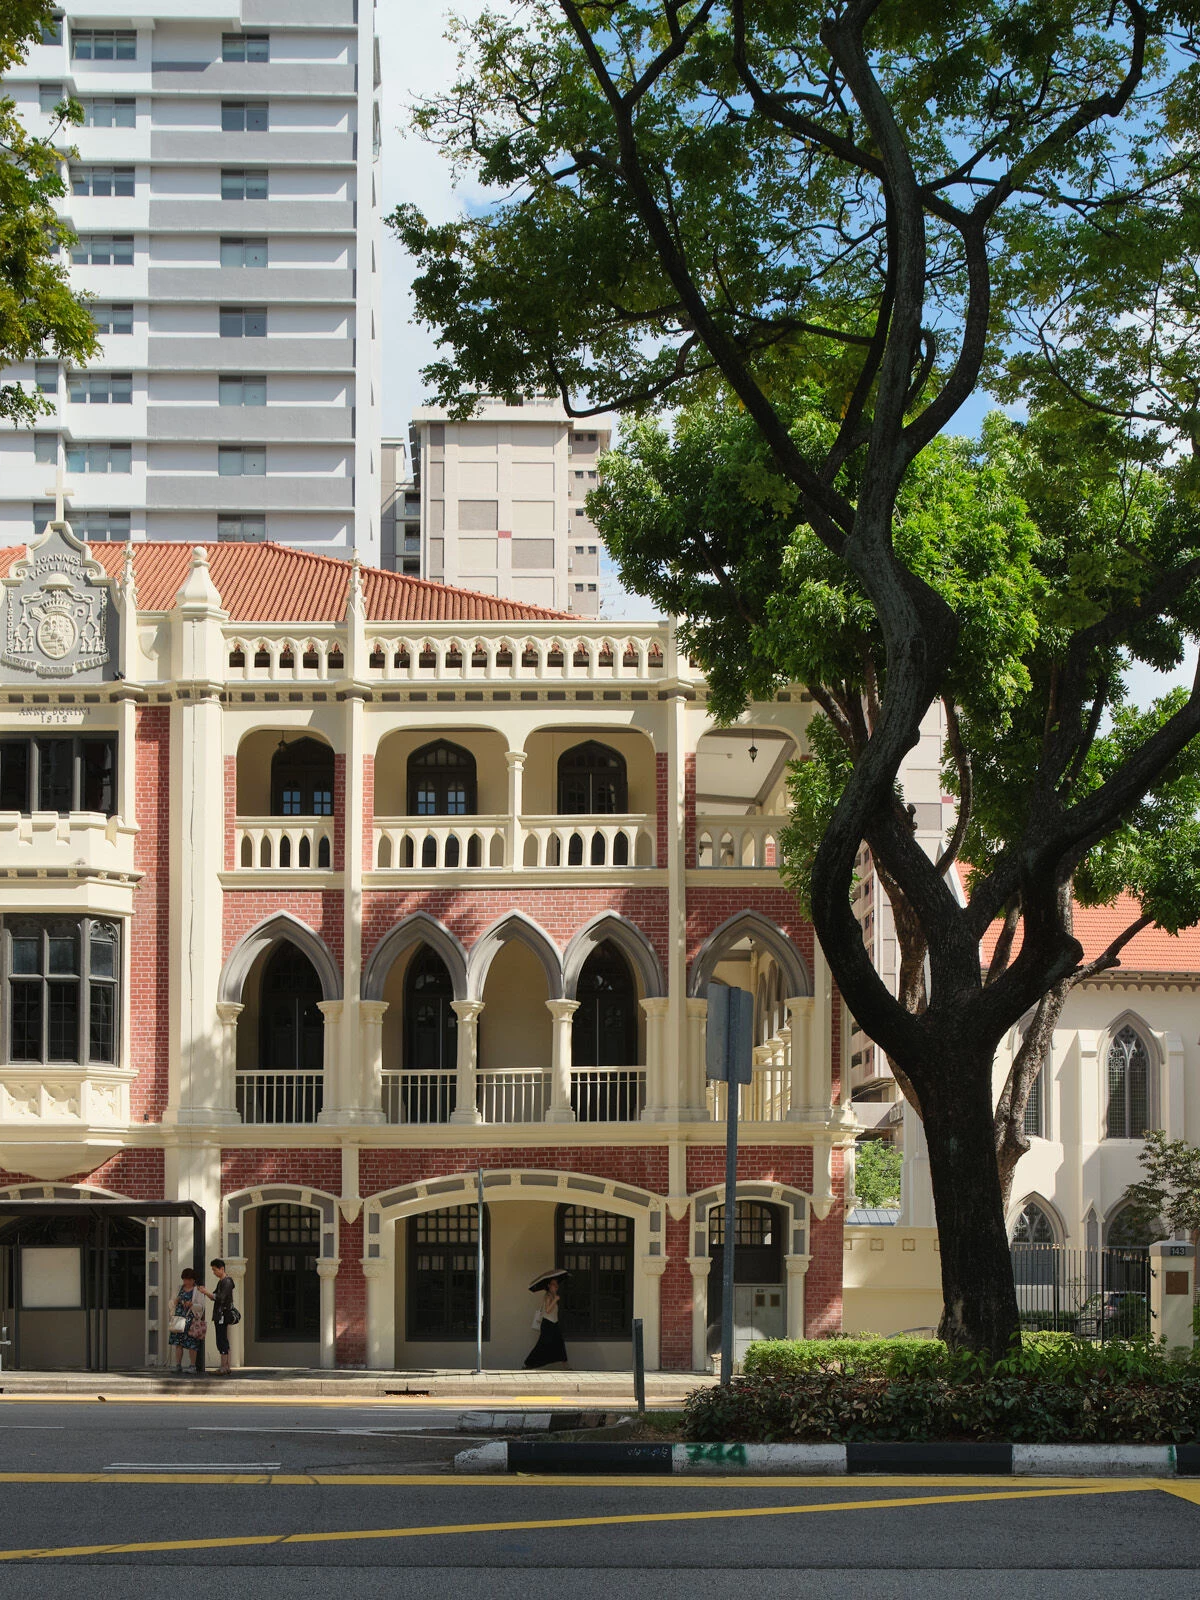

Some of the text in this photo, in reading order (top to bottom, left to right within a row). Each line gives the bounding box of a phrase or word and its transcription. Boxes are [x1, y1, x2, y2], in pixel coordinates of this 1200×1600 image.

[35, 553, 80, 566] JOANNES
[29, 563, 84, 580] PAULINUS
[19, 706, 91, 716] ANNO DOMINI
[40, 715, 68, 723] 1912
[1171, 1247, 1185, 1255] 143
